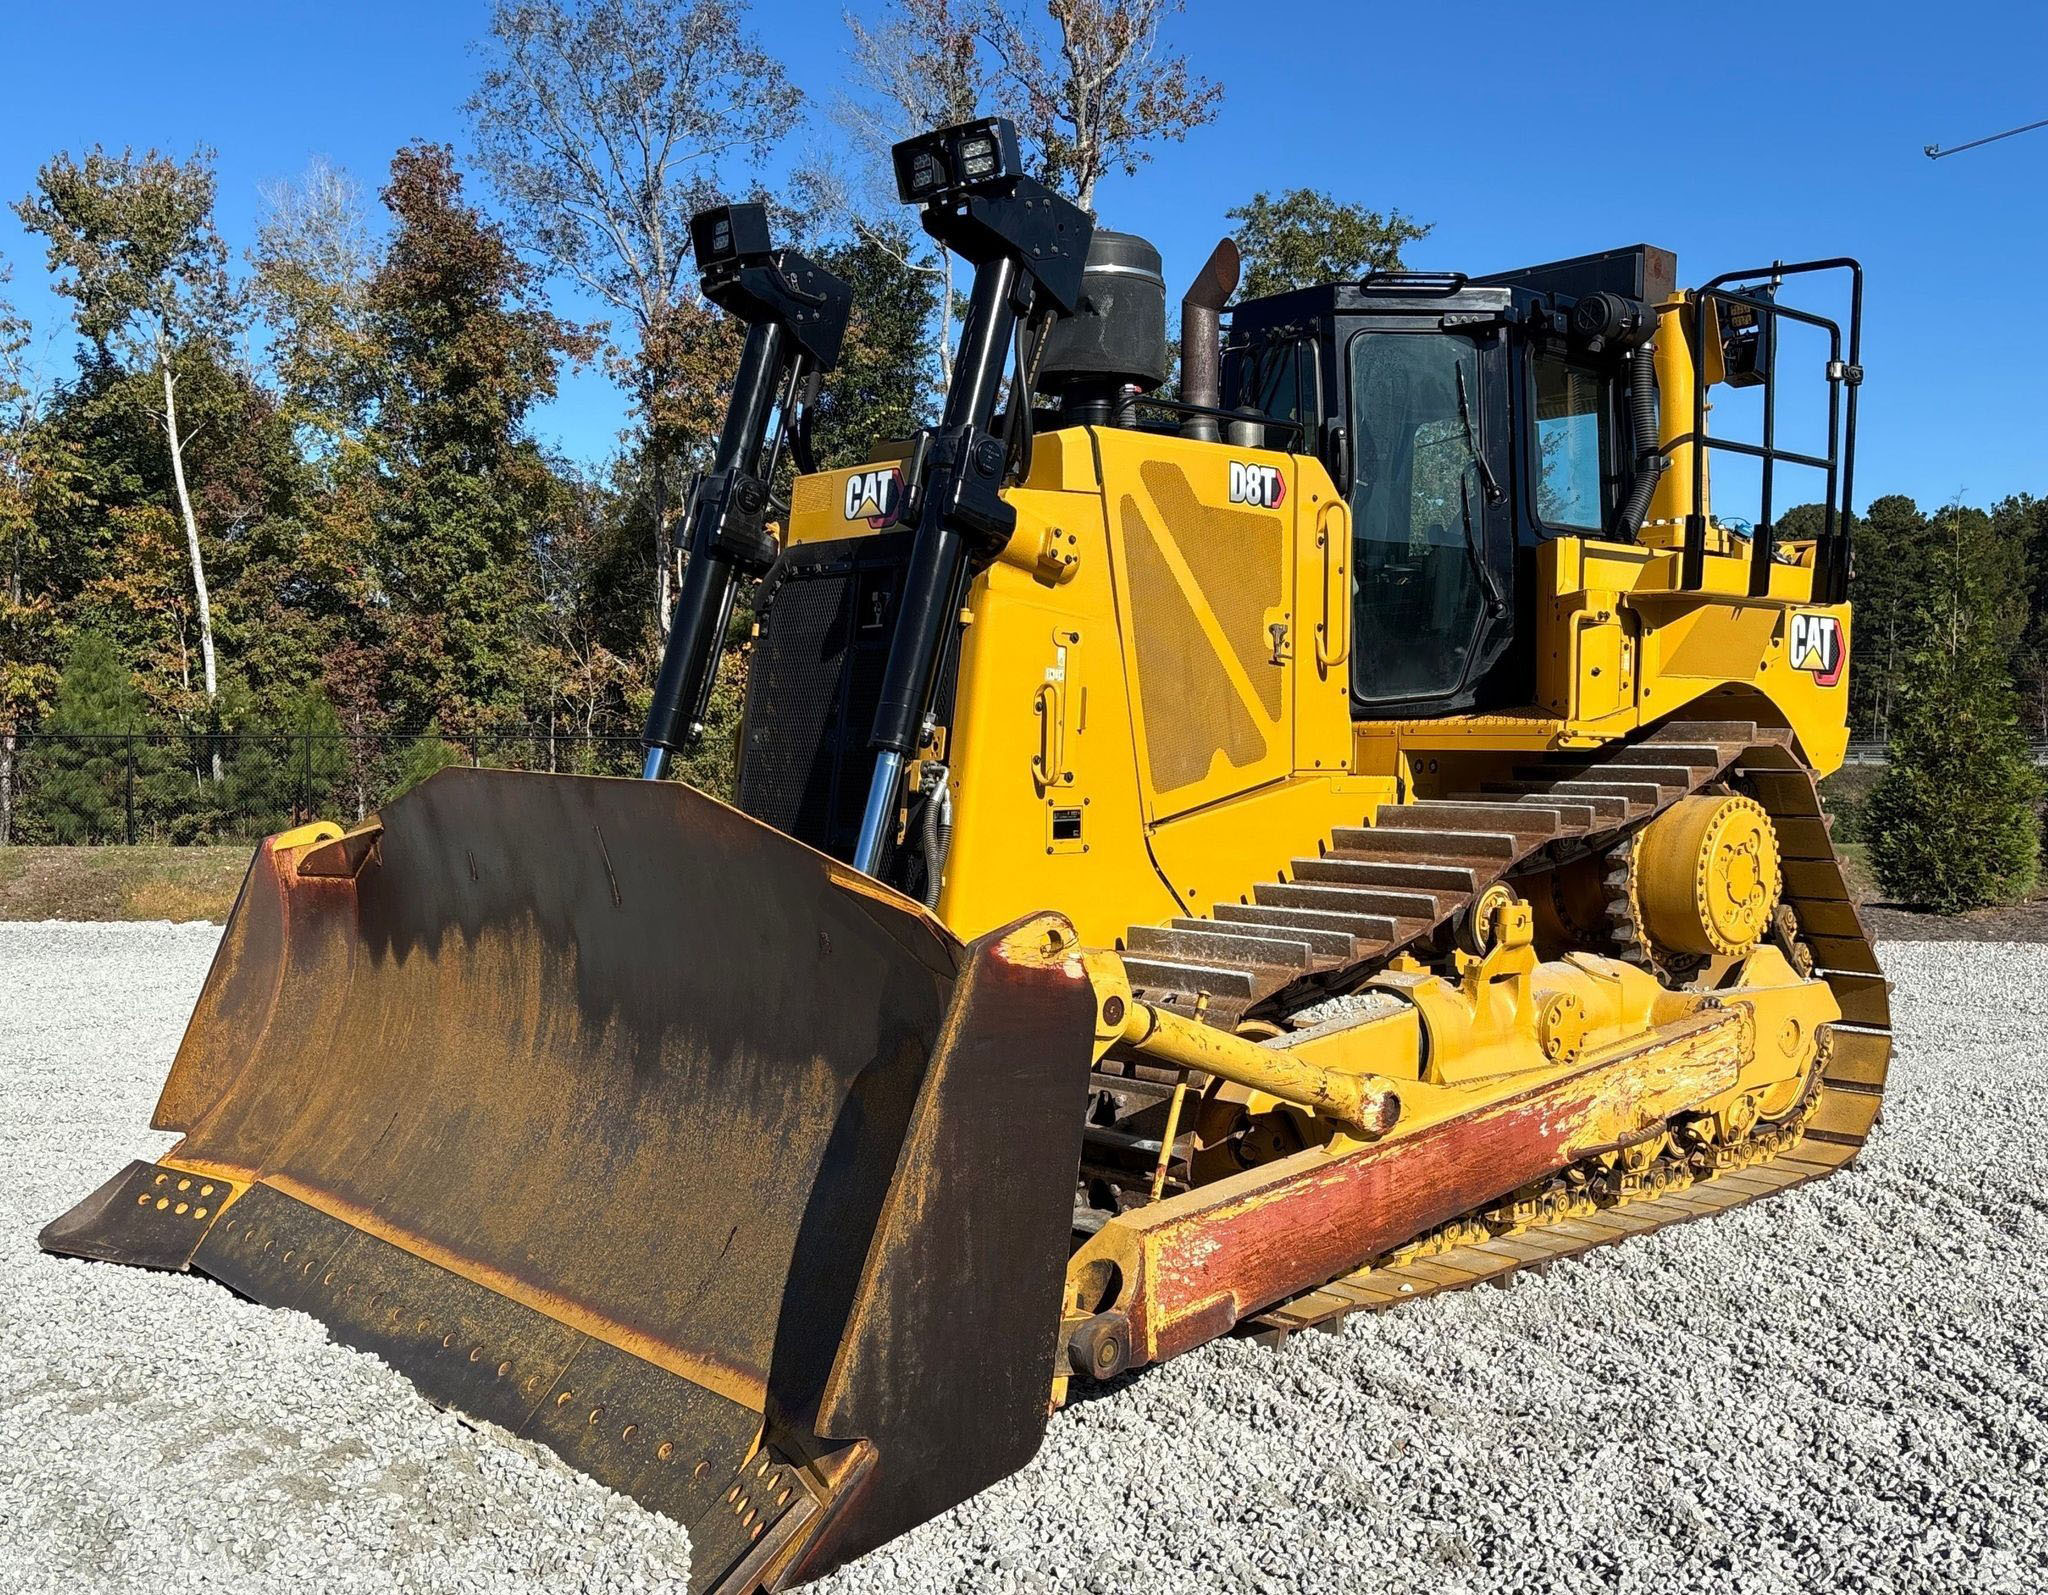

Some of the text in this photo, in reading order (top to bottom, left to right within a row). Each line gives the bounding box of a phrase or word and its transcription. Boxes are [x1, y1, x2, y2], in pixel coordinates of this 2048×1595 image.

[845, 469, 893, 520] CAT
[1229, 461, 1277, 507] D8T
[1790, 614, 1835, 671] CAT
